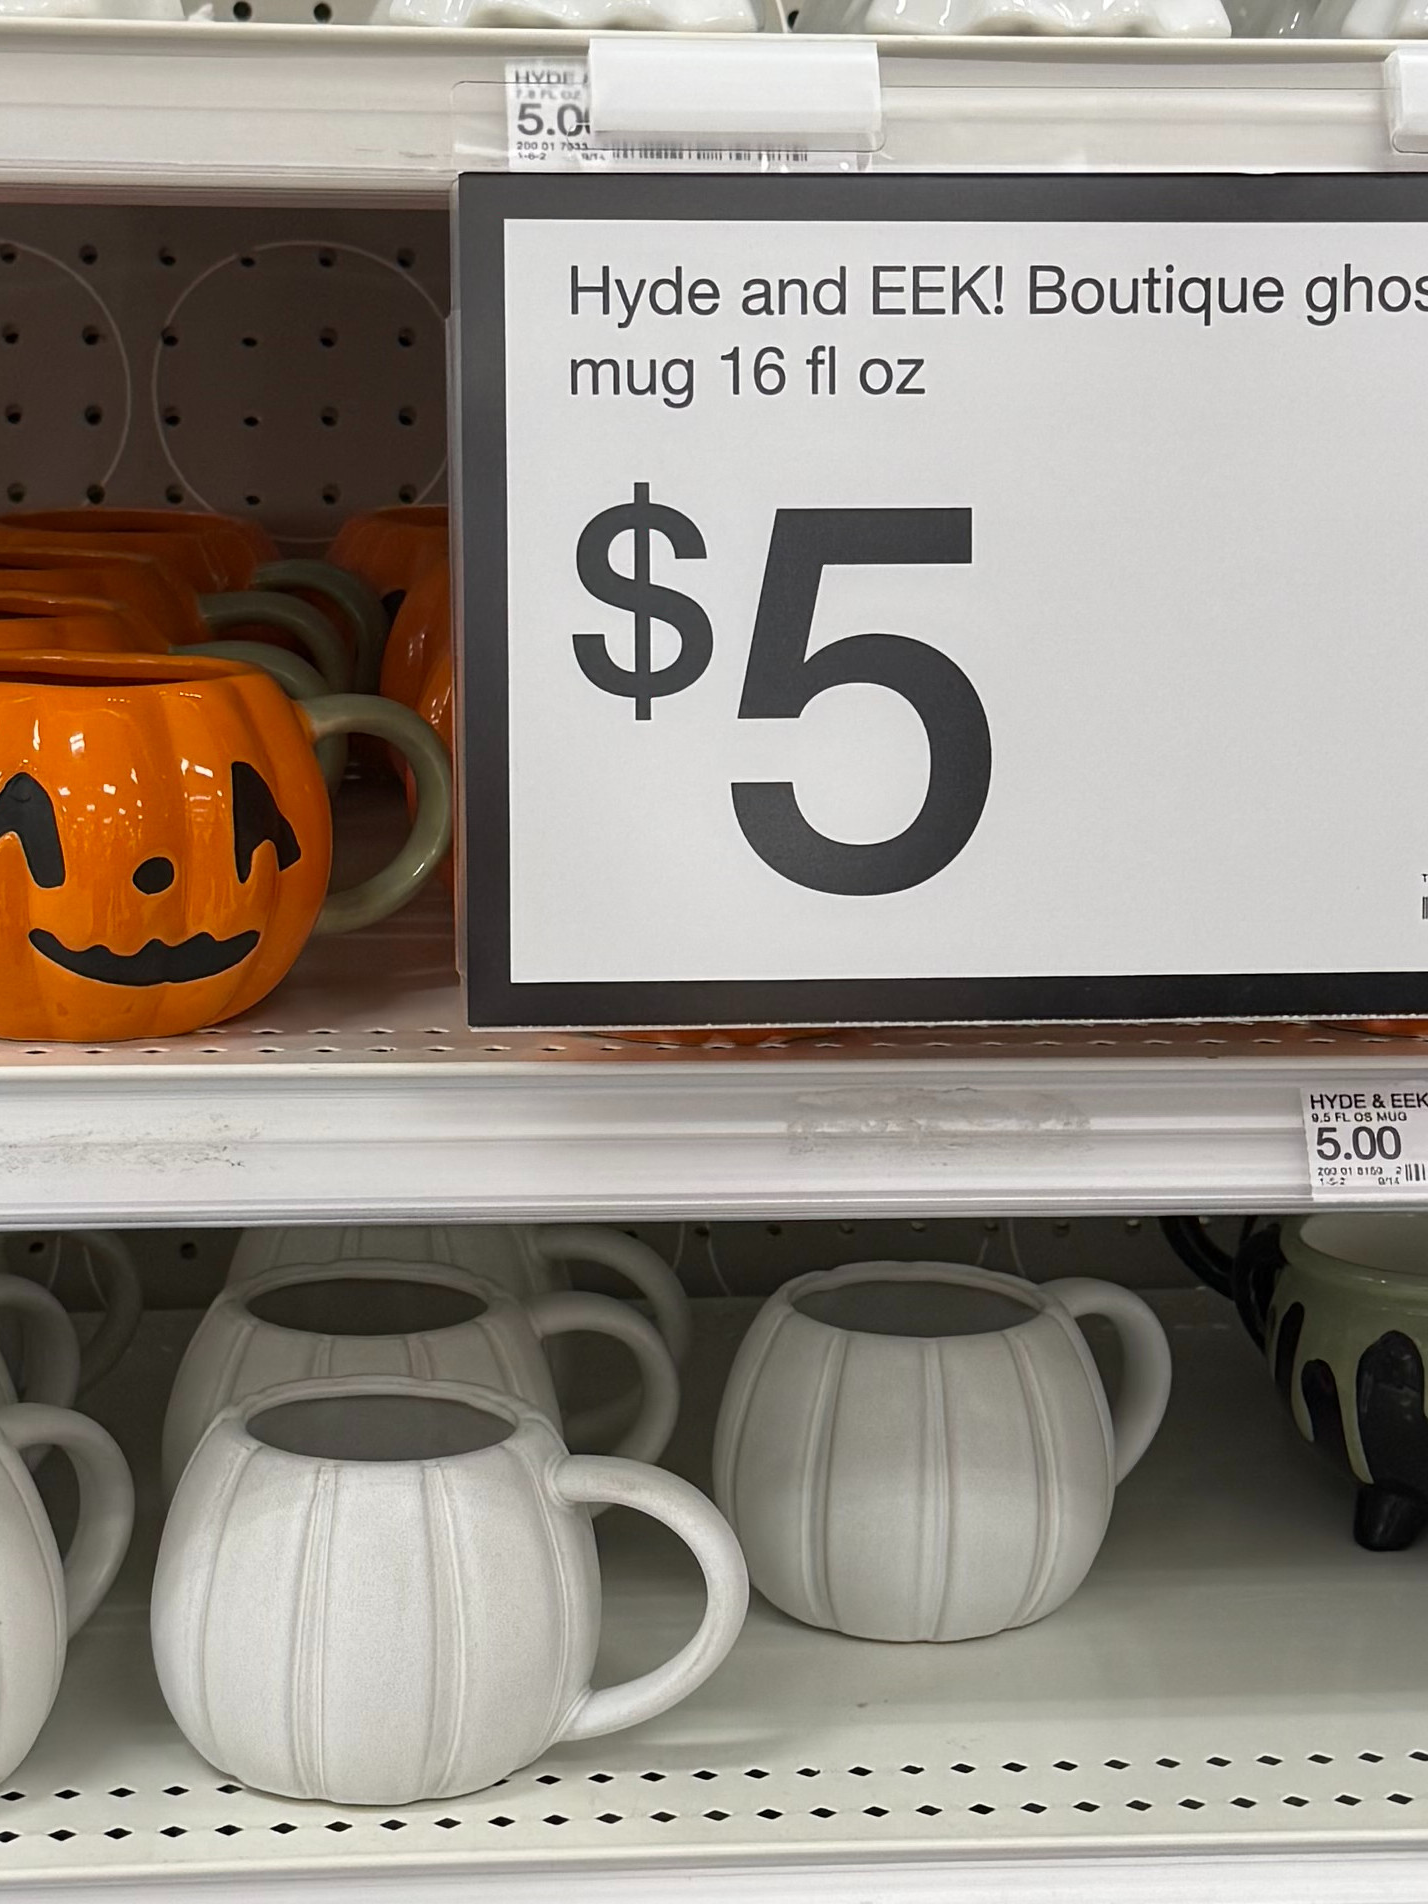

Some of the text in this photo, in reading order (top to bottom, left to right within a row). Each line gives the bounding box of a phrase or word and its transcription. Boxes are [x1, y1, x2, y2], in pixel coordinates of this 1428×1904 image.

[517, 103, 590, 136] 5.0
[569, 264, 721, 331] Hyde
[741, 263, 848, 315] and
[871, 264, 1004, 315] EEK!
[1029, 264, 1285, 327] Boutique
[569, 345, 926, 408] mug 16 fl oz
[572, 481, 993, 898] $5
[1310, 1094, 1366, 1110] HYDE
[1372, 1095, 1385, 1108] &
[1312, 1113, 1330, 1122] 9.5
[1335, 1113, 1350, 1122] FL
[1377, 1112, 1407, 1122] MUG
[1317, 1126, 1401, 1160] 5.00
